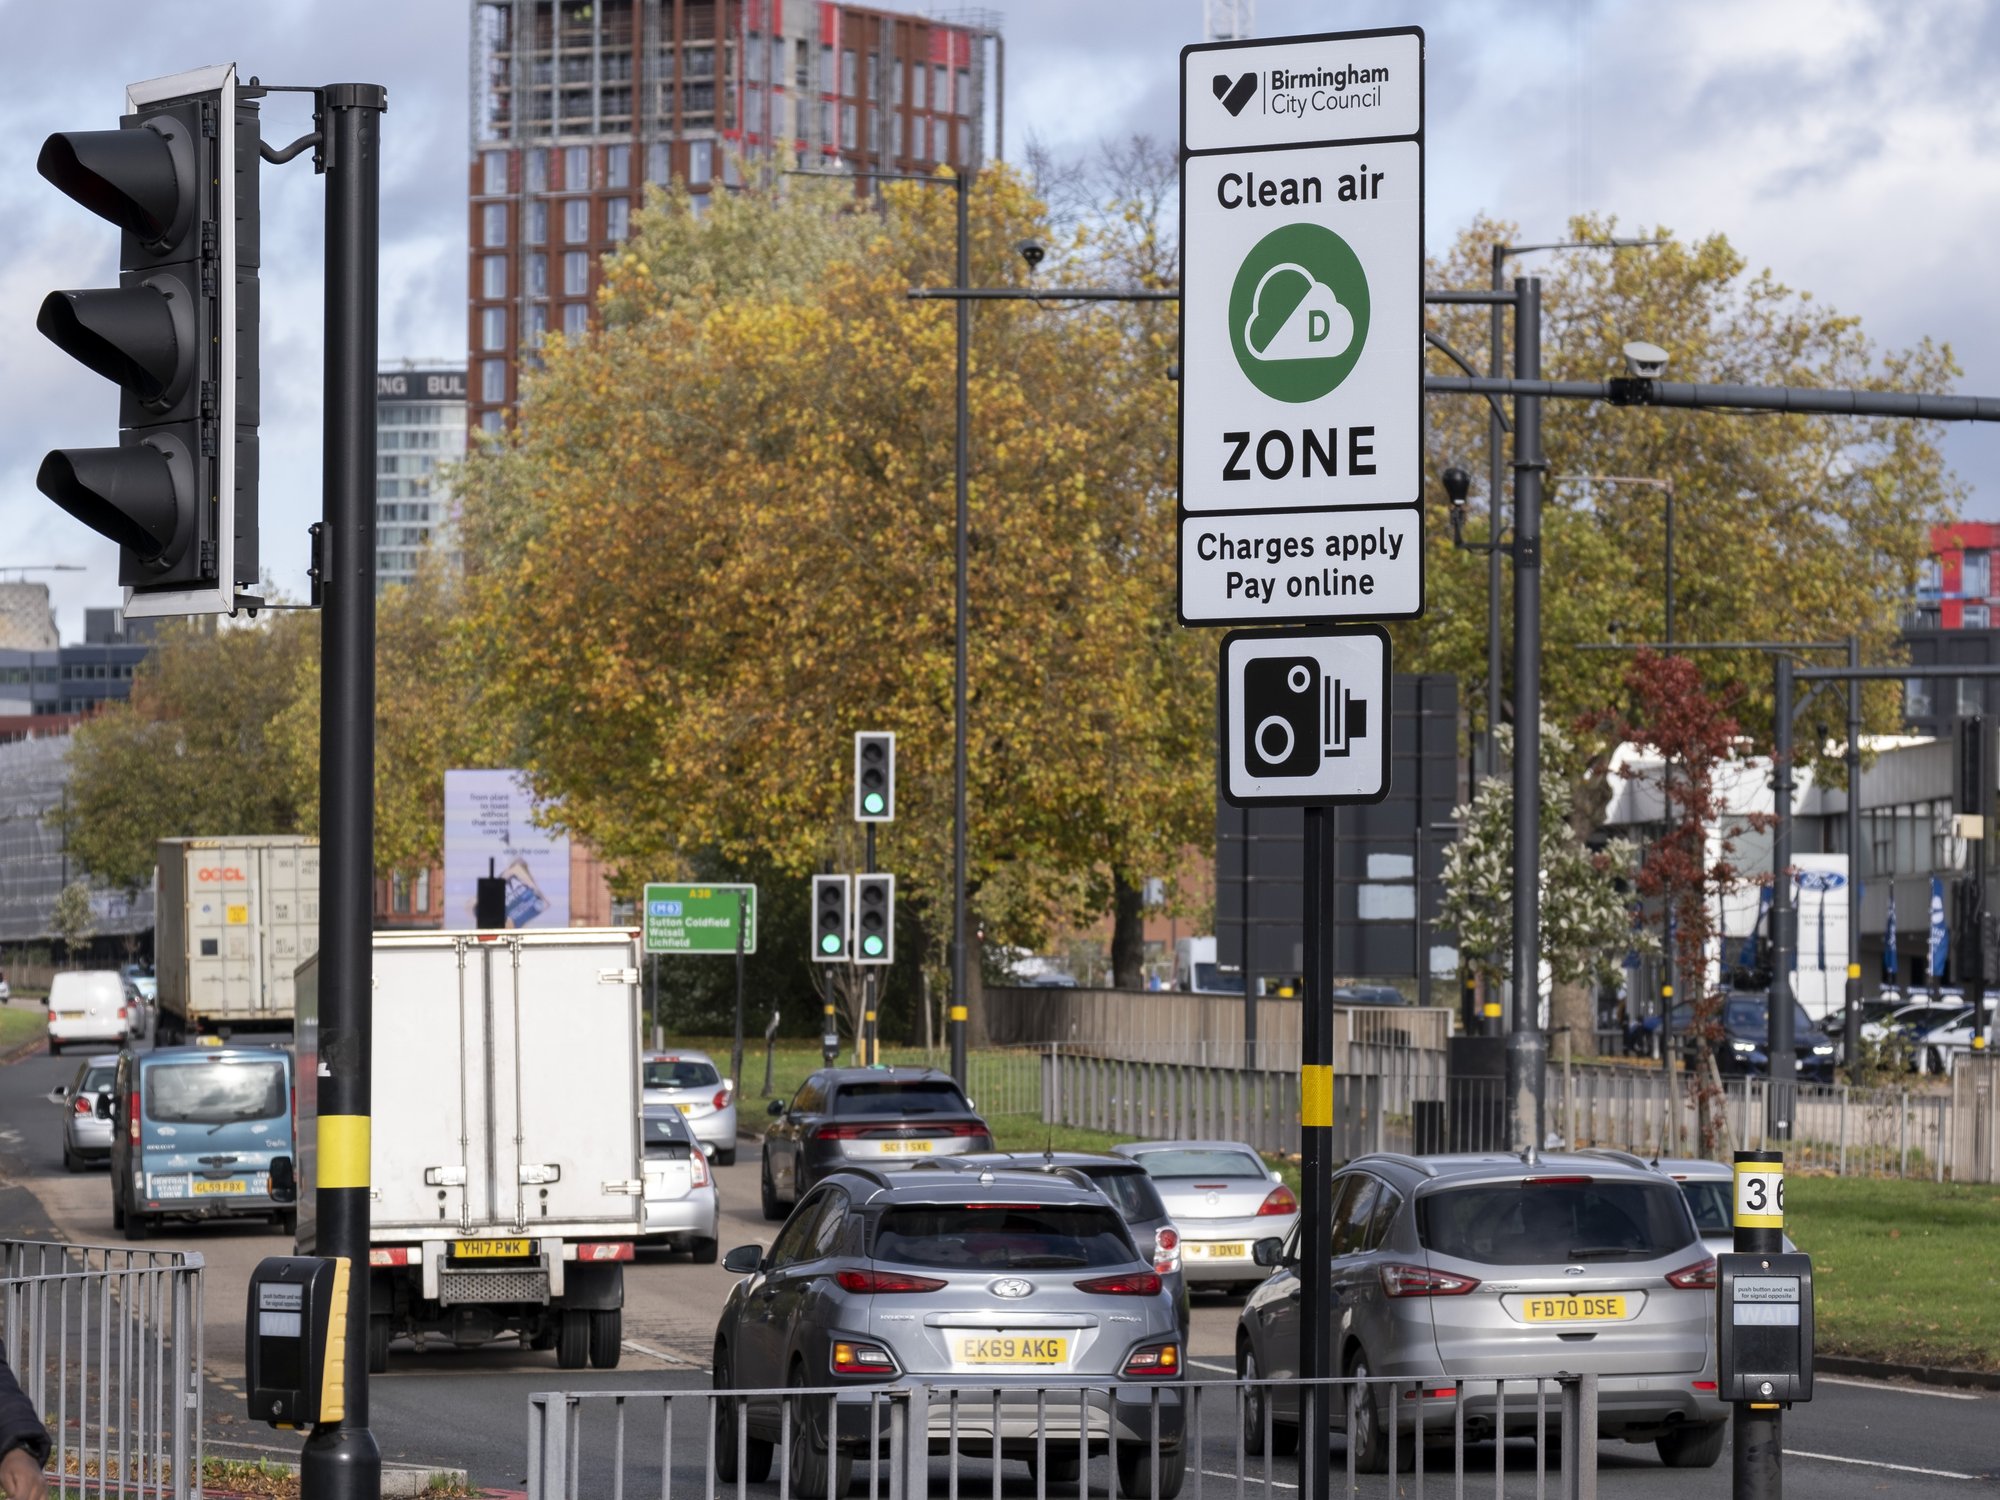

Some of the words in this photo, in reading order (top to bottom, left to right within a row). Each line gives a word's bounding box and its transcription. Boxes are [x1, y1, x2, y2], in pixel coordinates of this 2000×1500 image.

[1271, 63, 1390, 92] Birmingham
[1271, 92, 1308, 118] City
[1311, 85, 1381, 112] Council
[1217, 171, 1323, 210] Clean
[1337, 163, 1385, 202] air
[1309, 309, 1330, 342] D
[1222, 425, 1377, 482] ZONE
[1197, 532, 1314, 565] Charges
[1325, 526, 1404, 562] apply
[1226, 571, 1276, 604] Pay
[1286, 567, 1375, 598] online
[689, 888, 712, 899] A38
[649, 917, 682, 927] Sutton
[685, 917, 730, 928] Coldfield
[649, 928, 685, 937] Walsall
[649, 938, 690, 947] Lichfield
[463, 1242, 492, 1255] YH17
[495, 1241, 521, 1254] PWK
[1583, 1299, 1618, 1315] DSE
[964, 1339, 1015, 1358] EK69
[1021, 1339, 1059, 1358] AKG
